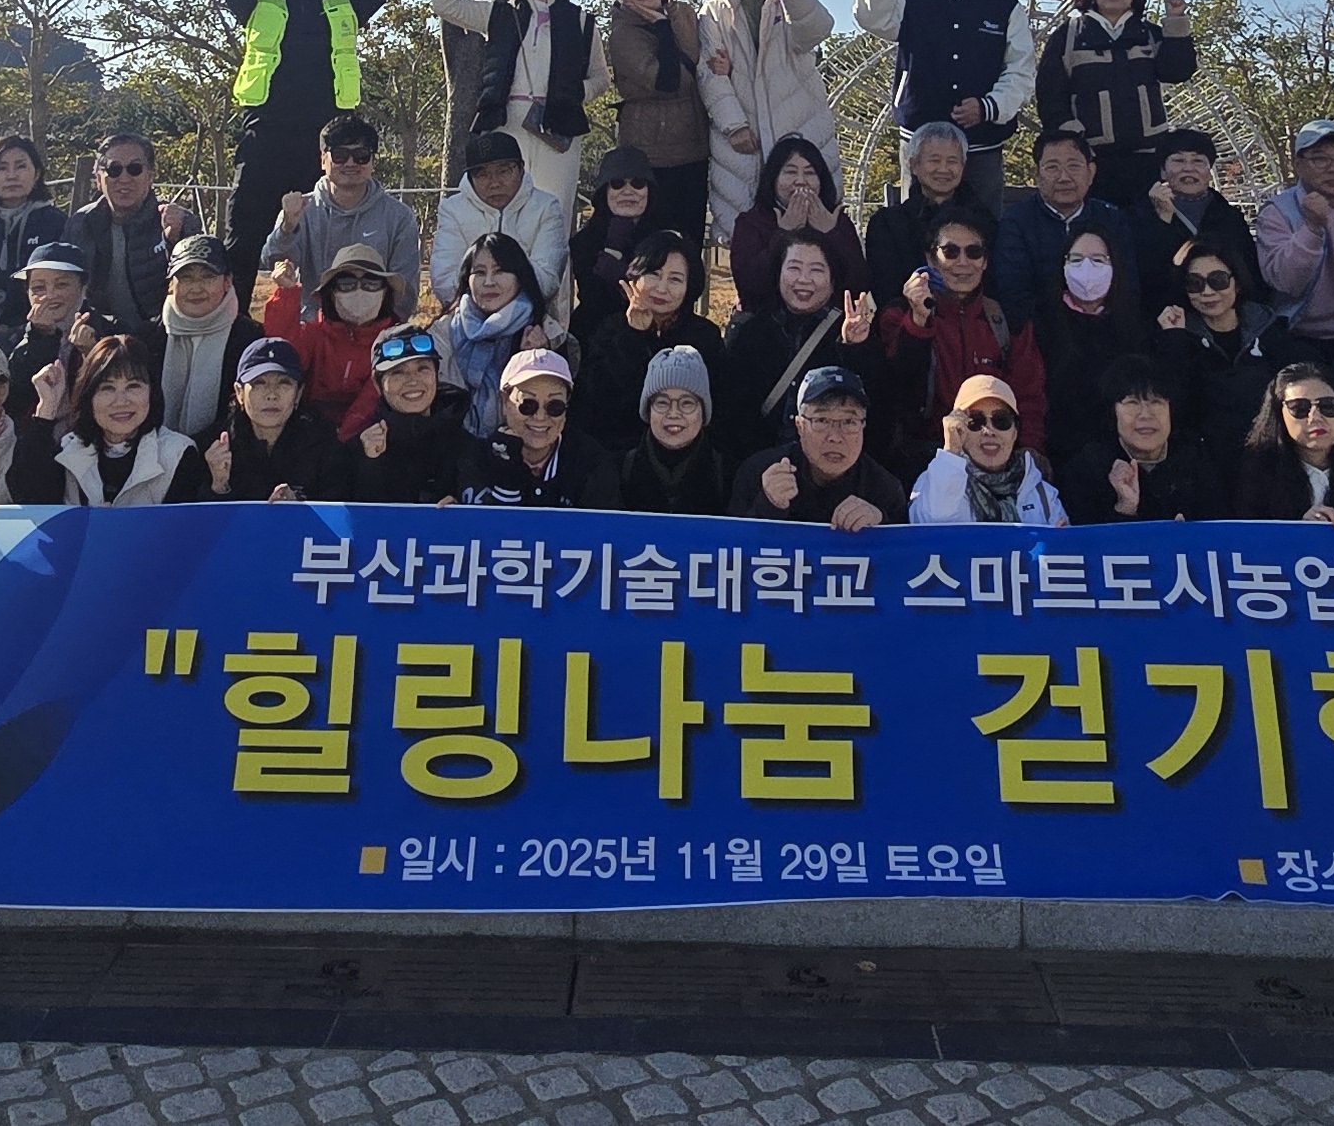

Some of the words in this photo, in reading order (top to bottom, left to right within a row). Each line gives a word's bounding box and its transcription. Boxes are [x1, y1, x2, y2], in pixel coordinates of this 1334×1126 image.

[291, 536, 876, 614] 부산과학기술대학교
[399, 836, 477, 881] 일시
[518, 836, 656, 881] 2025년
[677, 838, 763, 882] 11월
[779, 842, 868, 884] 29일
[885, 843, 1007, 886] 토요일
